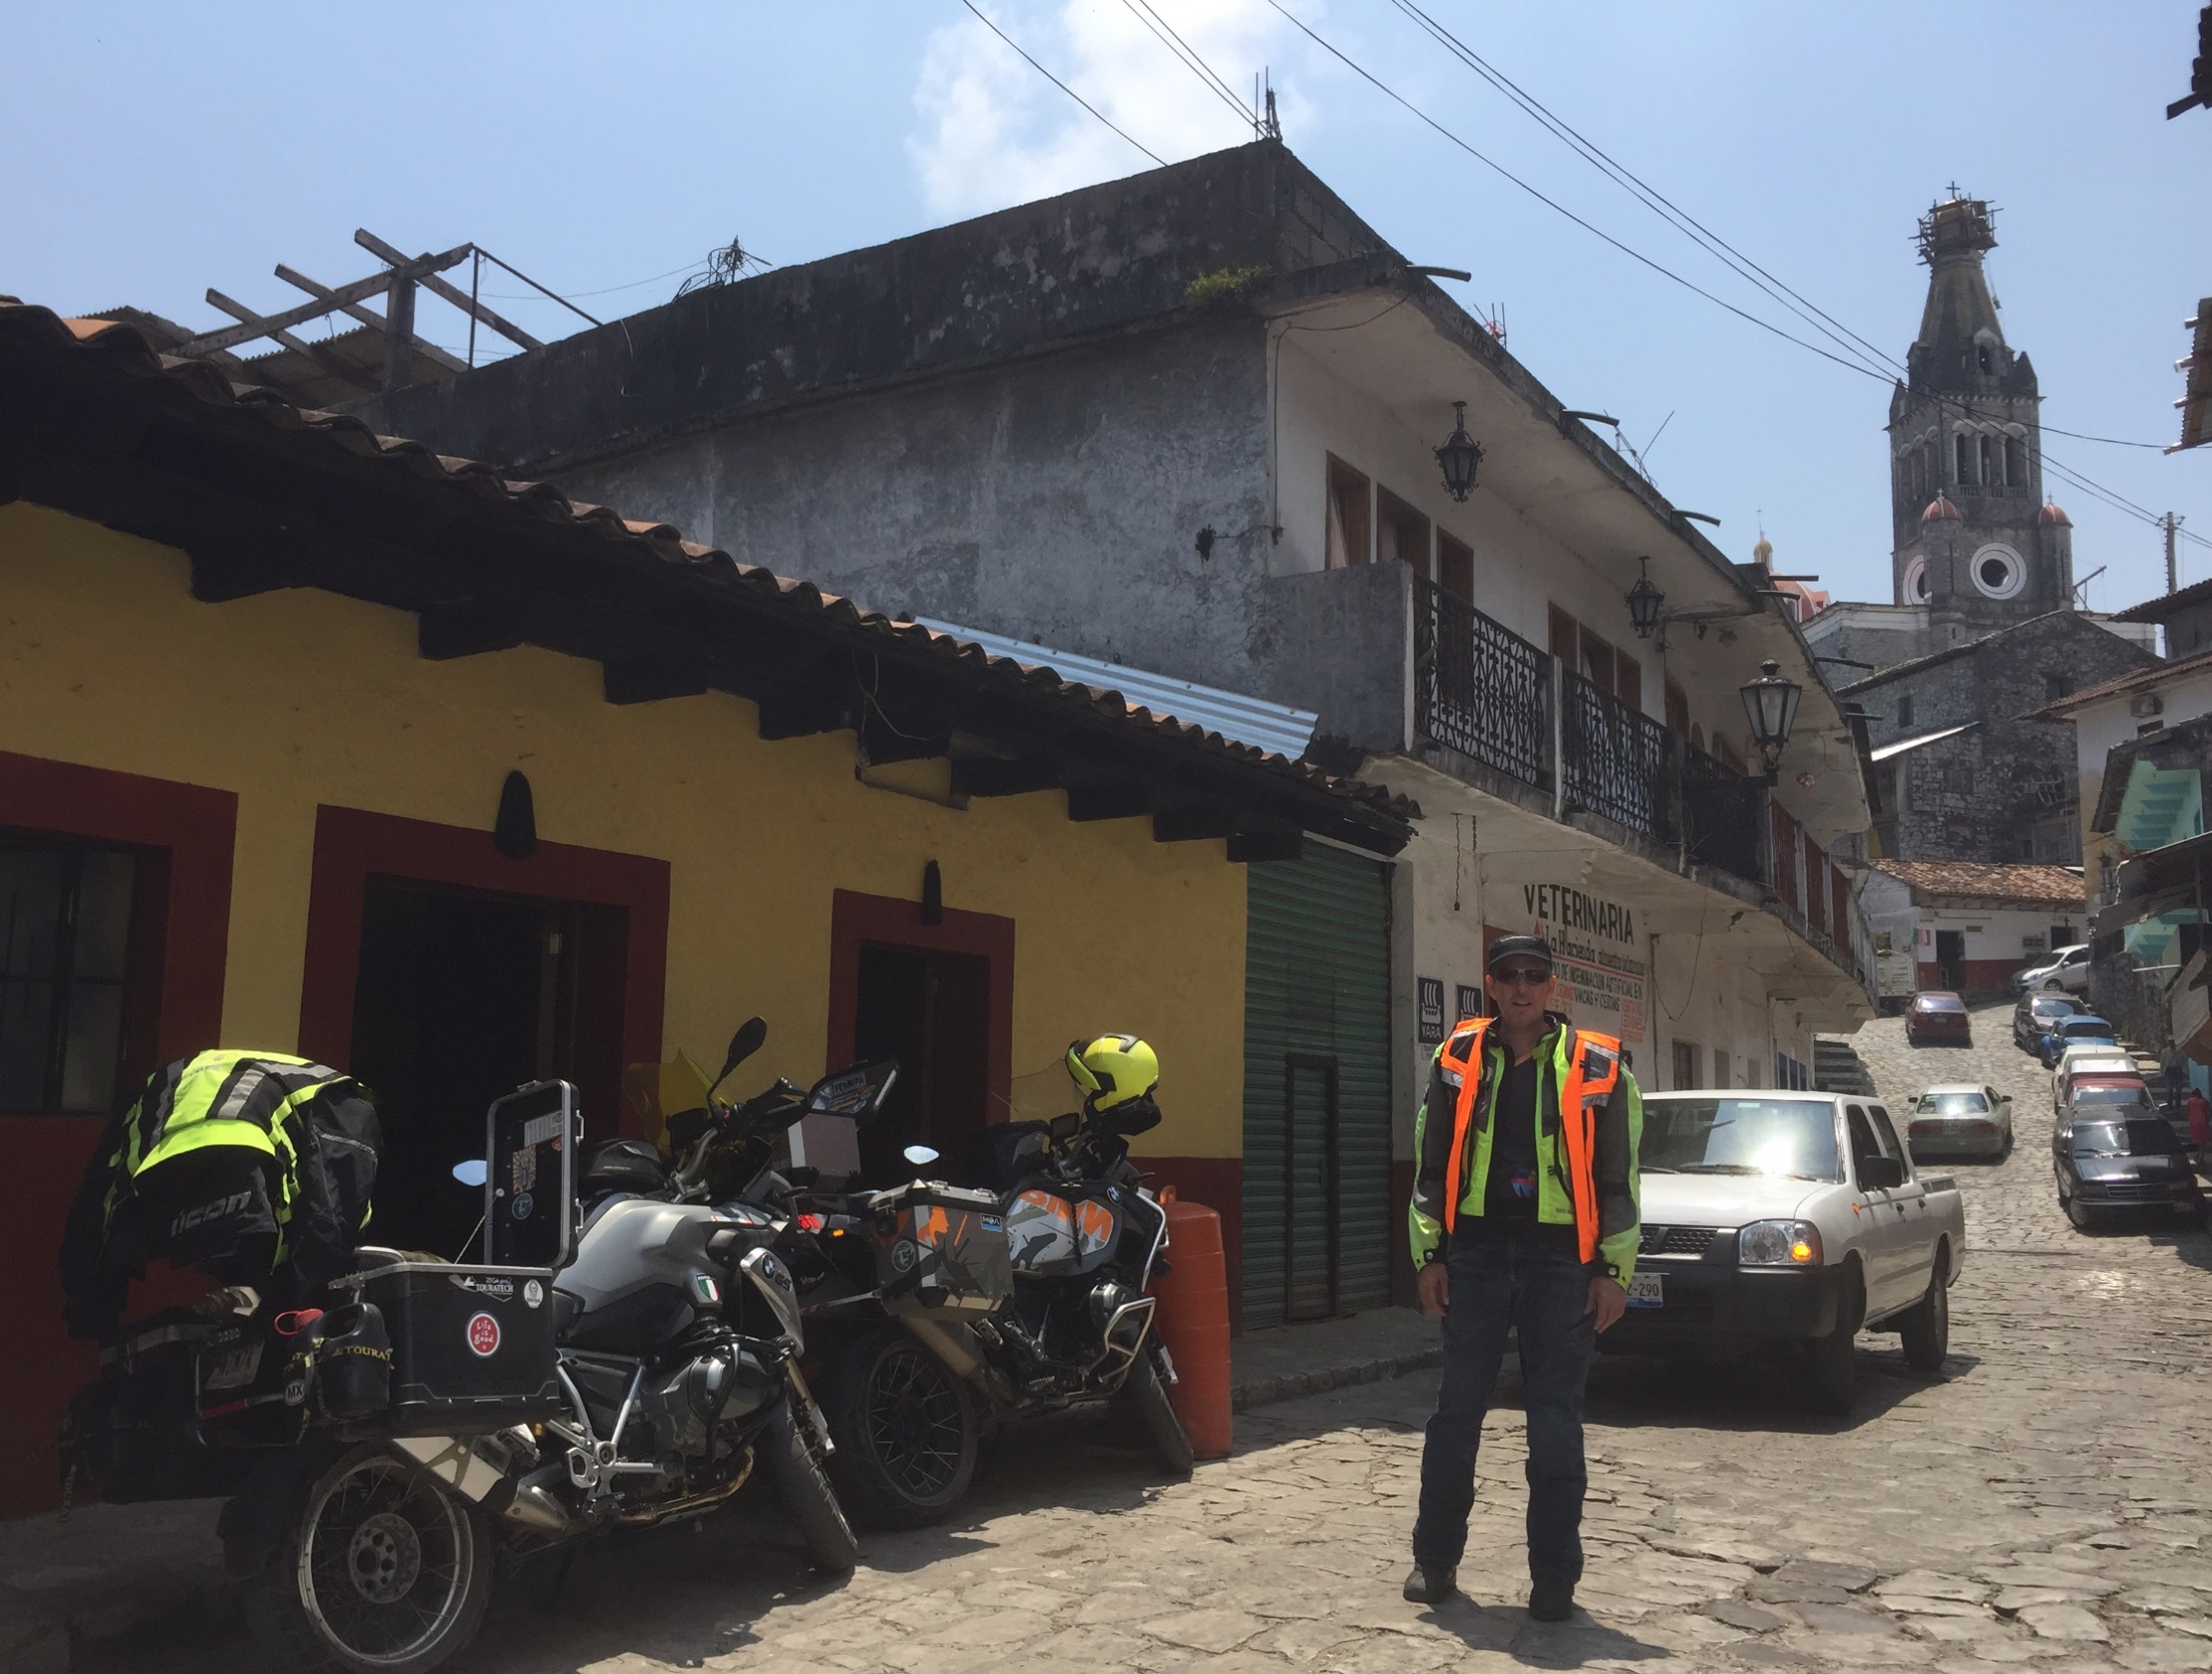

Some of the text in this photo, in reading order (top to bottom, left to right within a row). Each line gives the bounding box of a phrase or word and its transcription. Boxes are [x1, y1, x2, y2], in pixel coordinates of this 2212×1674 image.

[1524, 884, 1634, 945] VETERINARIA
[1559, 928, 1595, 963] Hacienda
[1421, 1025, 1442, 1039] YARA
[476, 1283, 514, 1293] TOURATECH
[774, 1273, 792, 1292] GS
[477, 1320, 492, 1330] Life
[287, 1384, 303, 1399] MX
